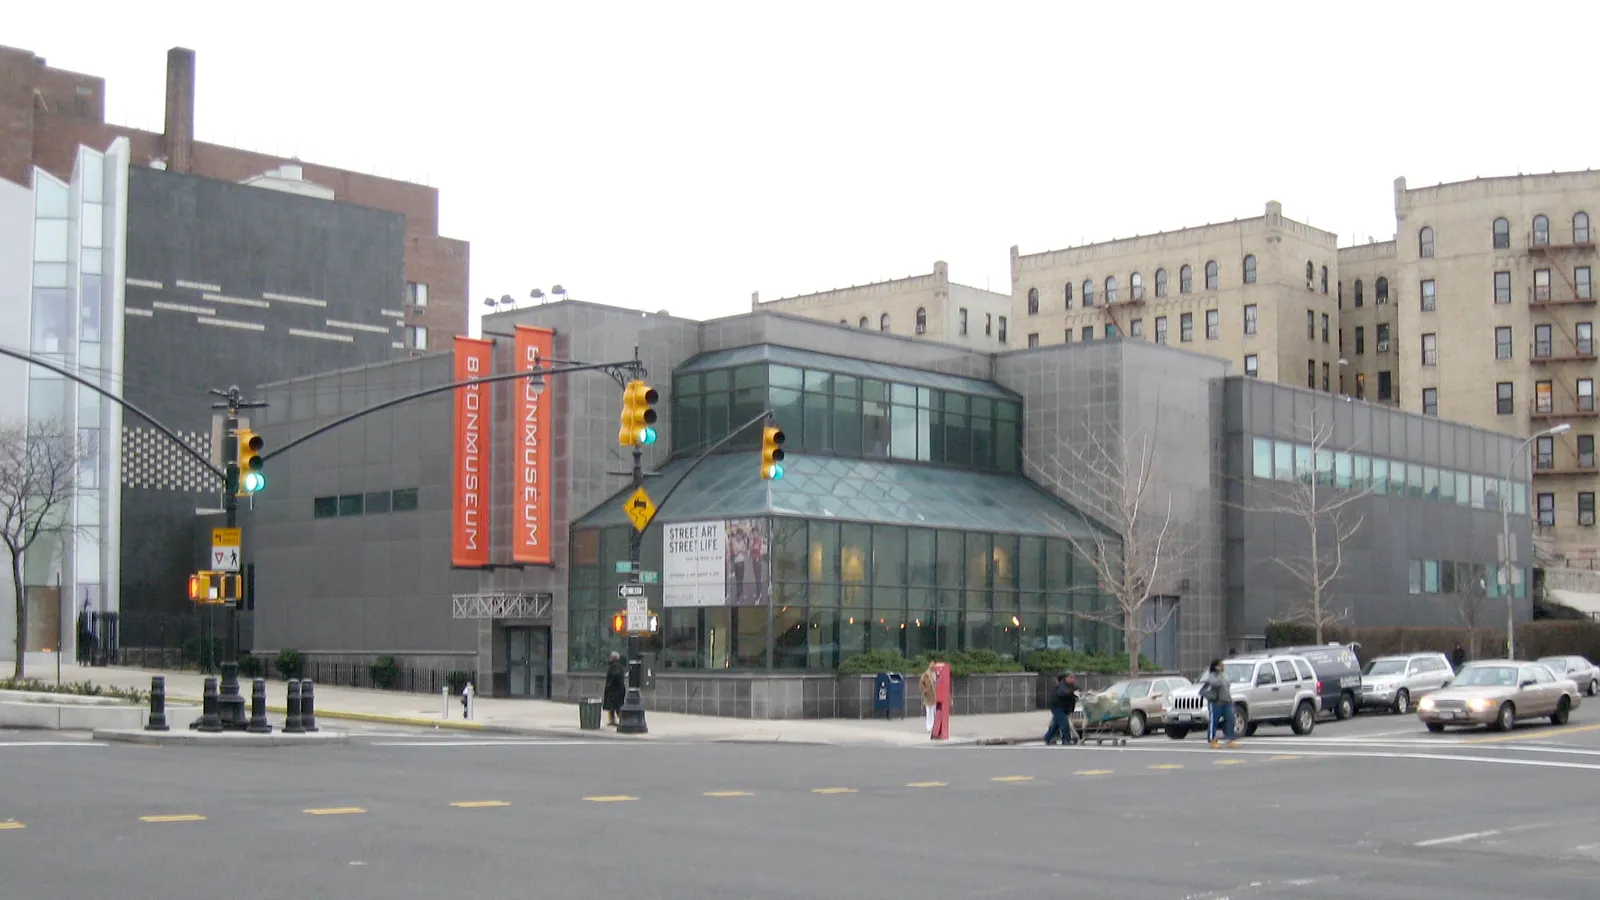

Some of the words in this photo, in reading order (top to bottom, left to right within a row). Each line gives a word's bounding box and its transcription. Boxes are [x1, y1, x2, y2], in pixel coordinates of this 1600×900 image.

[669, 526, 698, 539] STREET
[701, 525, 717, 537] ART
[669, 540, 697, 553] STREET
[700, 539, 717, 551] LIFE
